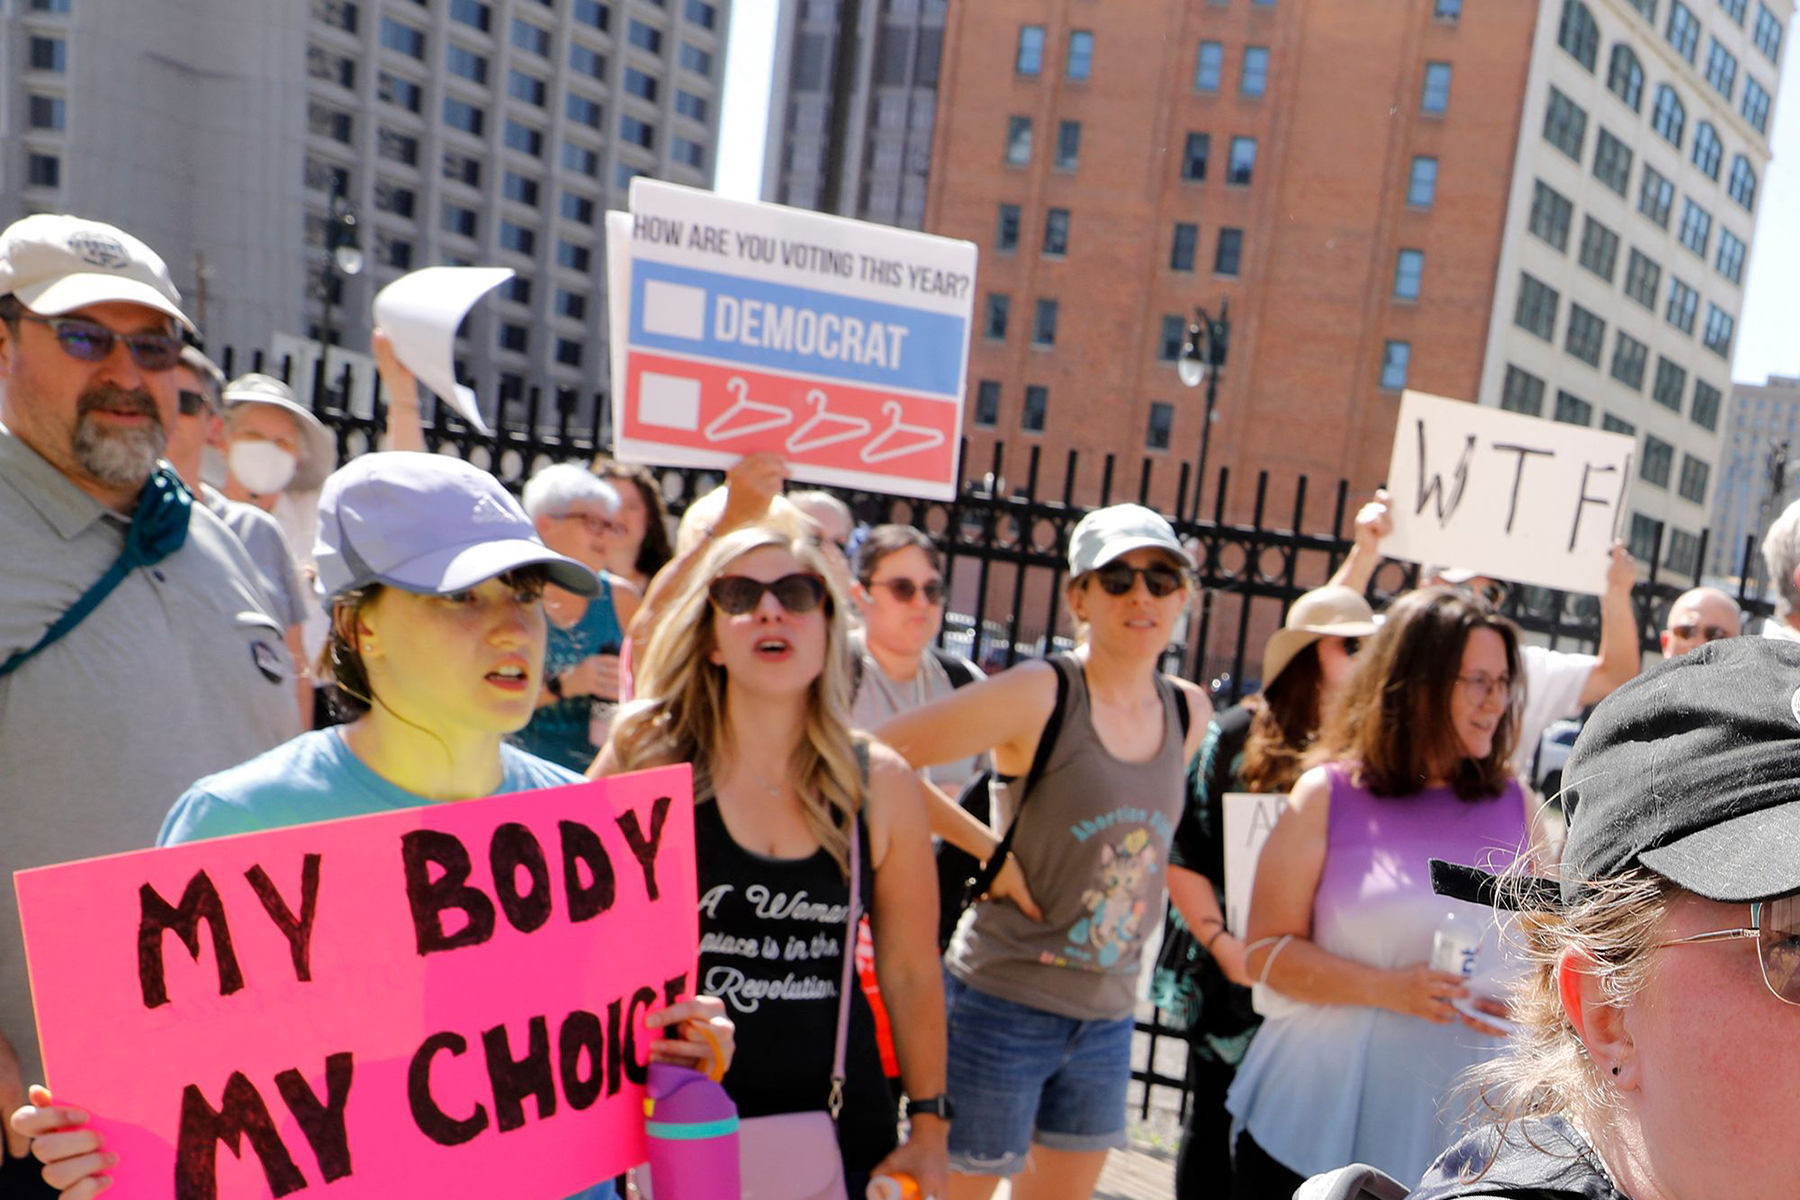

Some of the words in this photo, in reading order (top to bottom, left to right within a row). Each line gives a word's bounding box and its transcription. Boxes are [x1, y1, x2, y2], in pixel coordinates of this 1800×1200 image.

[633, 213, 684, 247] HOW
[686, 226, 729, 256] ARE
[736, 232, 776, 265] YOU
[781, 240, 853, 278] VOTING
[860, 255, 902, 288] THIS
[908, 264, 970, 299] YEAR?
[714, 293, 910, 371] DEMOCRAT
[138, 853, 322, 1009] MY
[401, 796, 672, 957] BODY
[698, 884, 735, 919] A
[761, 935, 780, 960] is
[783, 935, 809, 961] in
[809, 931, 840, 960] the
